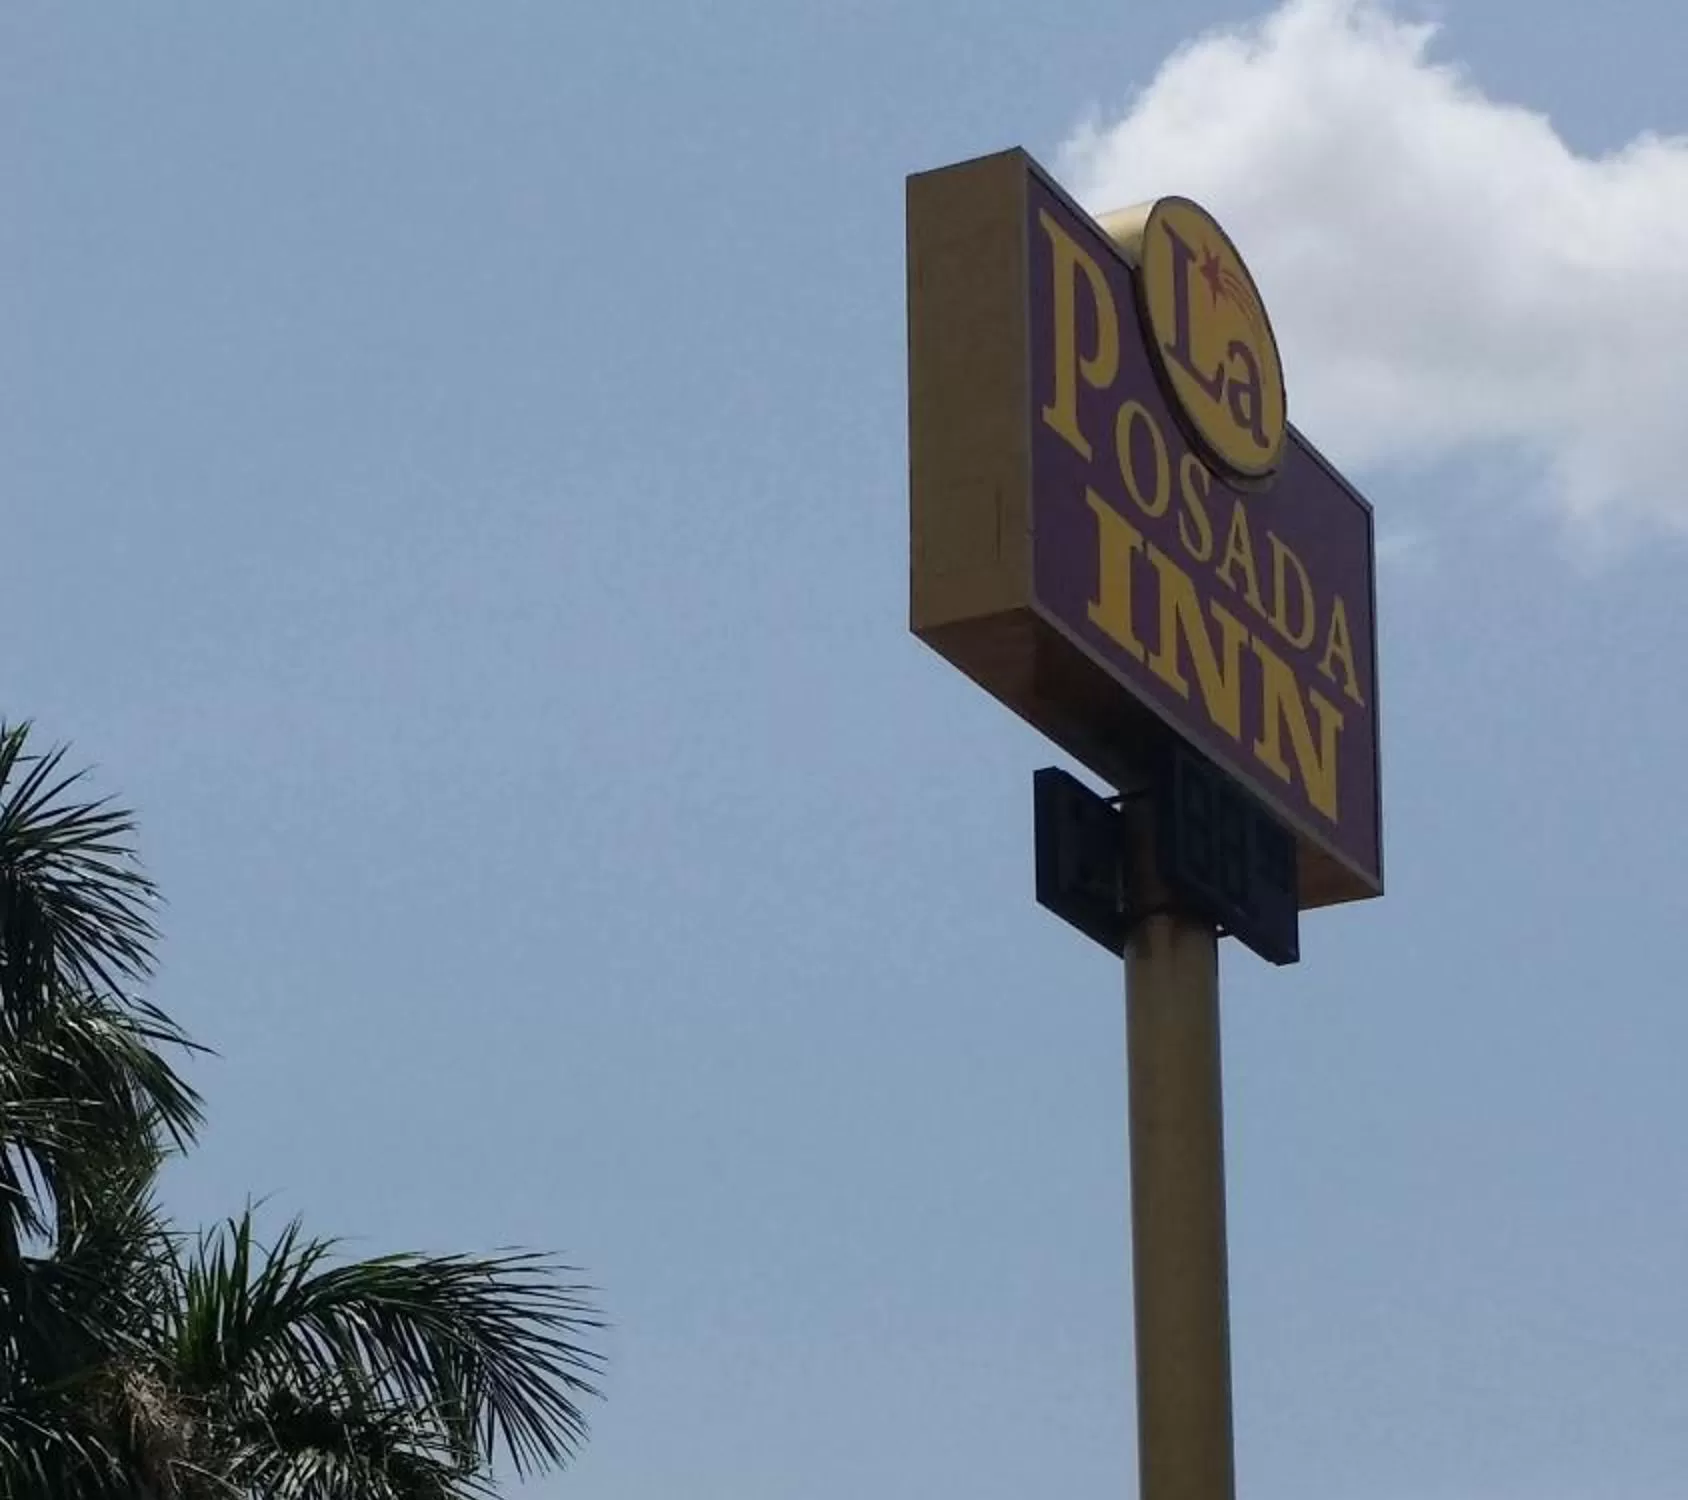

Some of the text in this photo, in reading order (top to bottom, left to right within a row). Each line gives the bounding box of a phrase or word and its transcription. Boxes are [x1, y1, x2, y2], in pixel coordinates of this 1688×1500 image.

[1039, 208, 1364, 706] POSADA
[1161, 218, 1267, 448] La
[1087, 488, 1344, 822] INN
